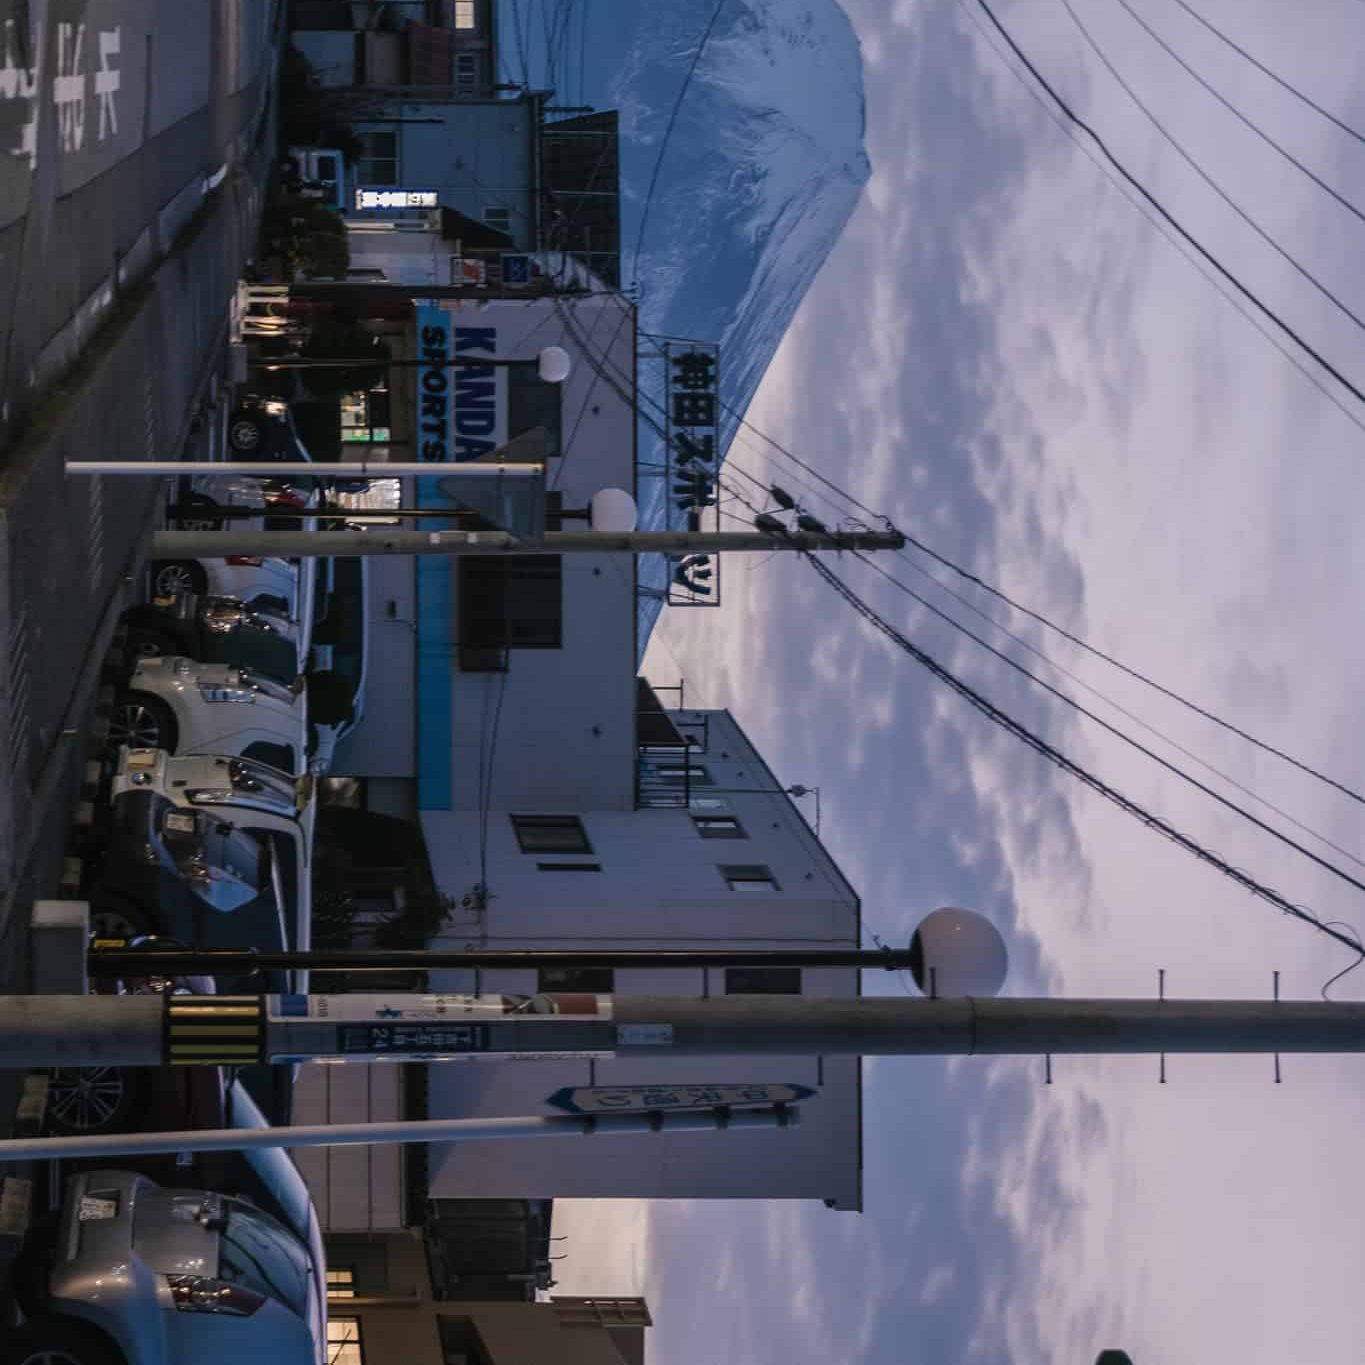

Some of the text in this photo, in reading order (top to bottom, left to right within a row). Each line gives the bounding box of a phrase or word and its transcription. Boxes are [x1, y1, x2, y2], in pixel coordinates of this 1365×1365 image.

[422, 325, 448, 461] SPORTS
[455, 327, 497, 463] KANDA
[370, 1026, 389, 1049] 24
